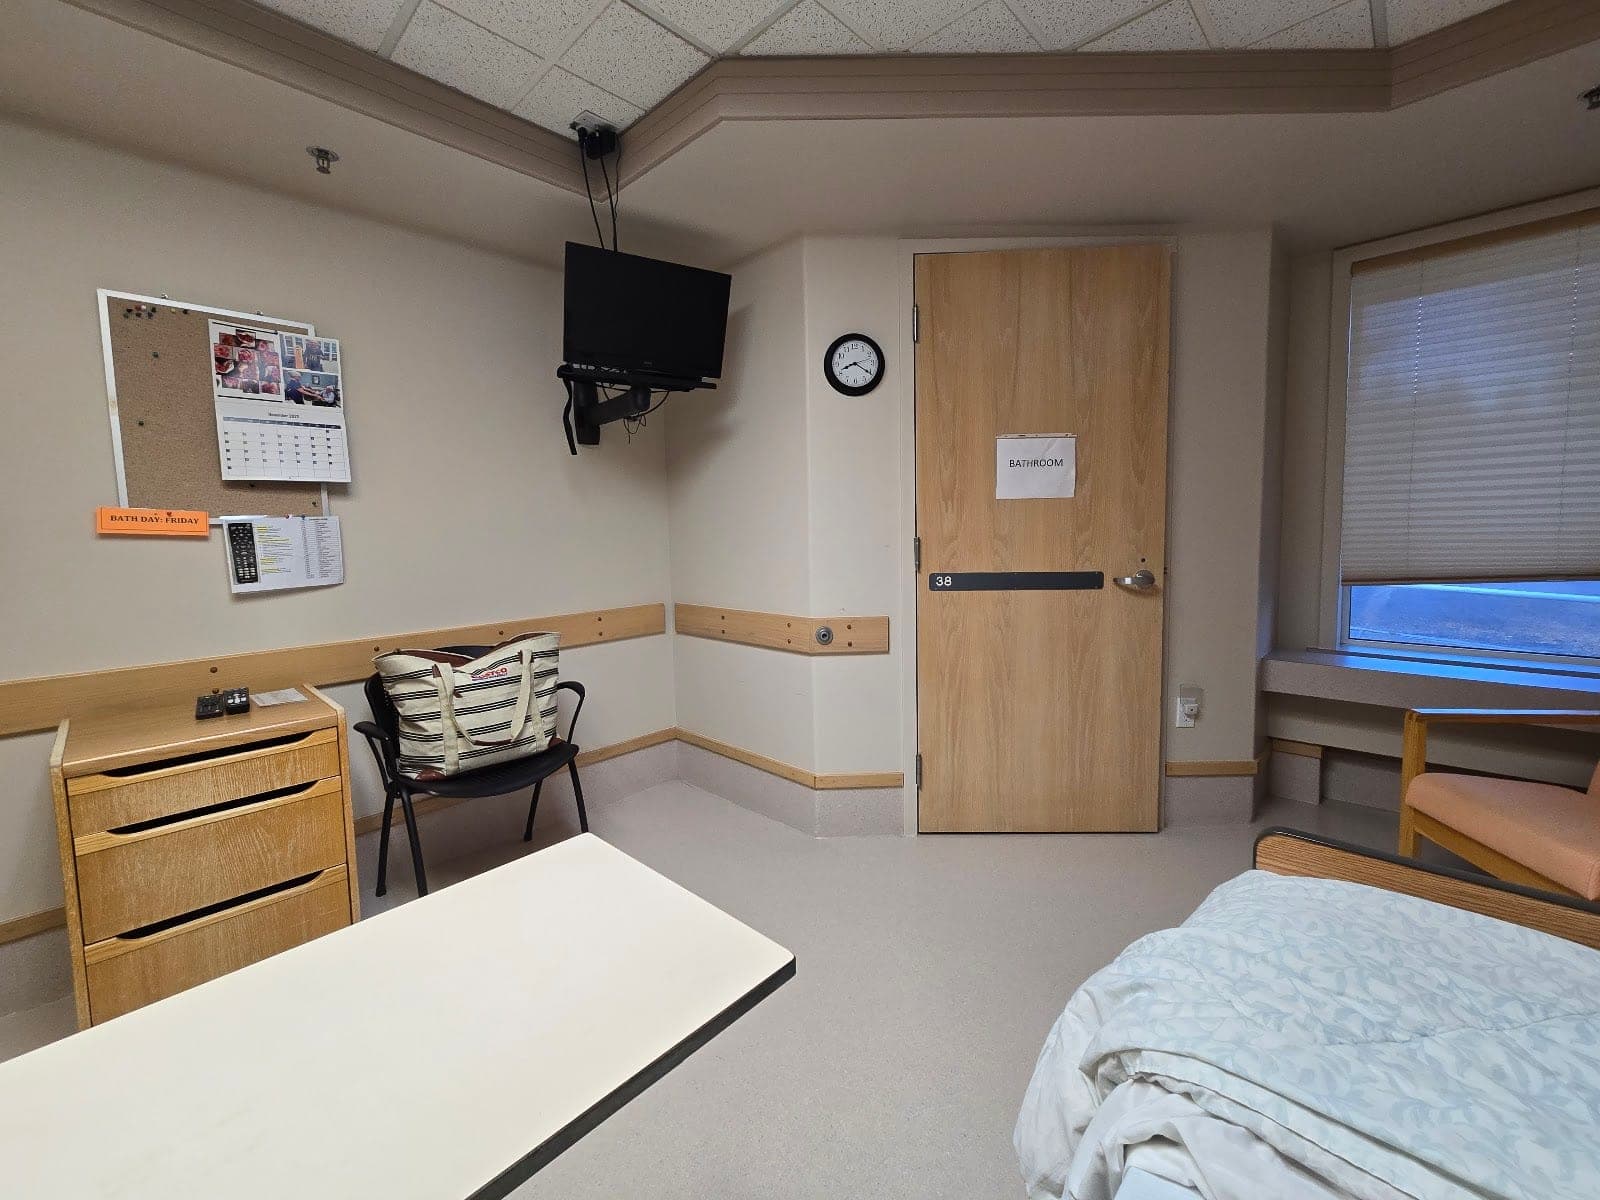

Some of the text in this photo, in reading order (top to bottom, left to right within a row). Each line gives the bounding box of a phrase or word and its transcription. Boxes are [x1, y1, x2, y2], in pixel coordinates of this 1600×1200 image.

[1009, 458, 1064, 468] BATHROOM
[110, 514, 138, 522] BATH
[165, 516, 200, 525] FRIDAY
[935, 576, 952, 587] 38
